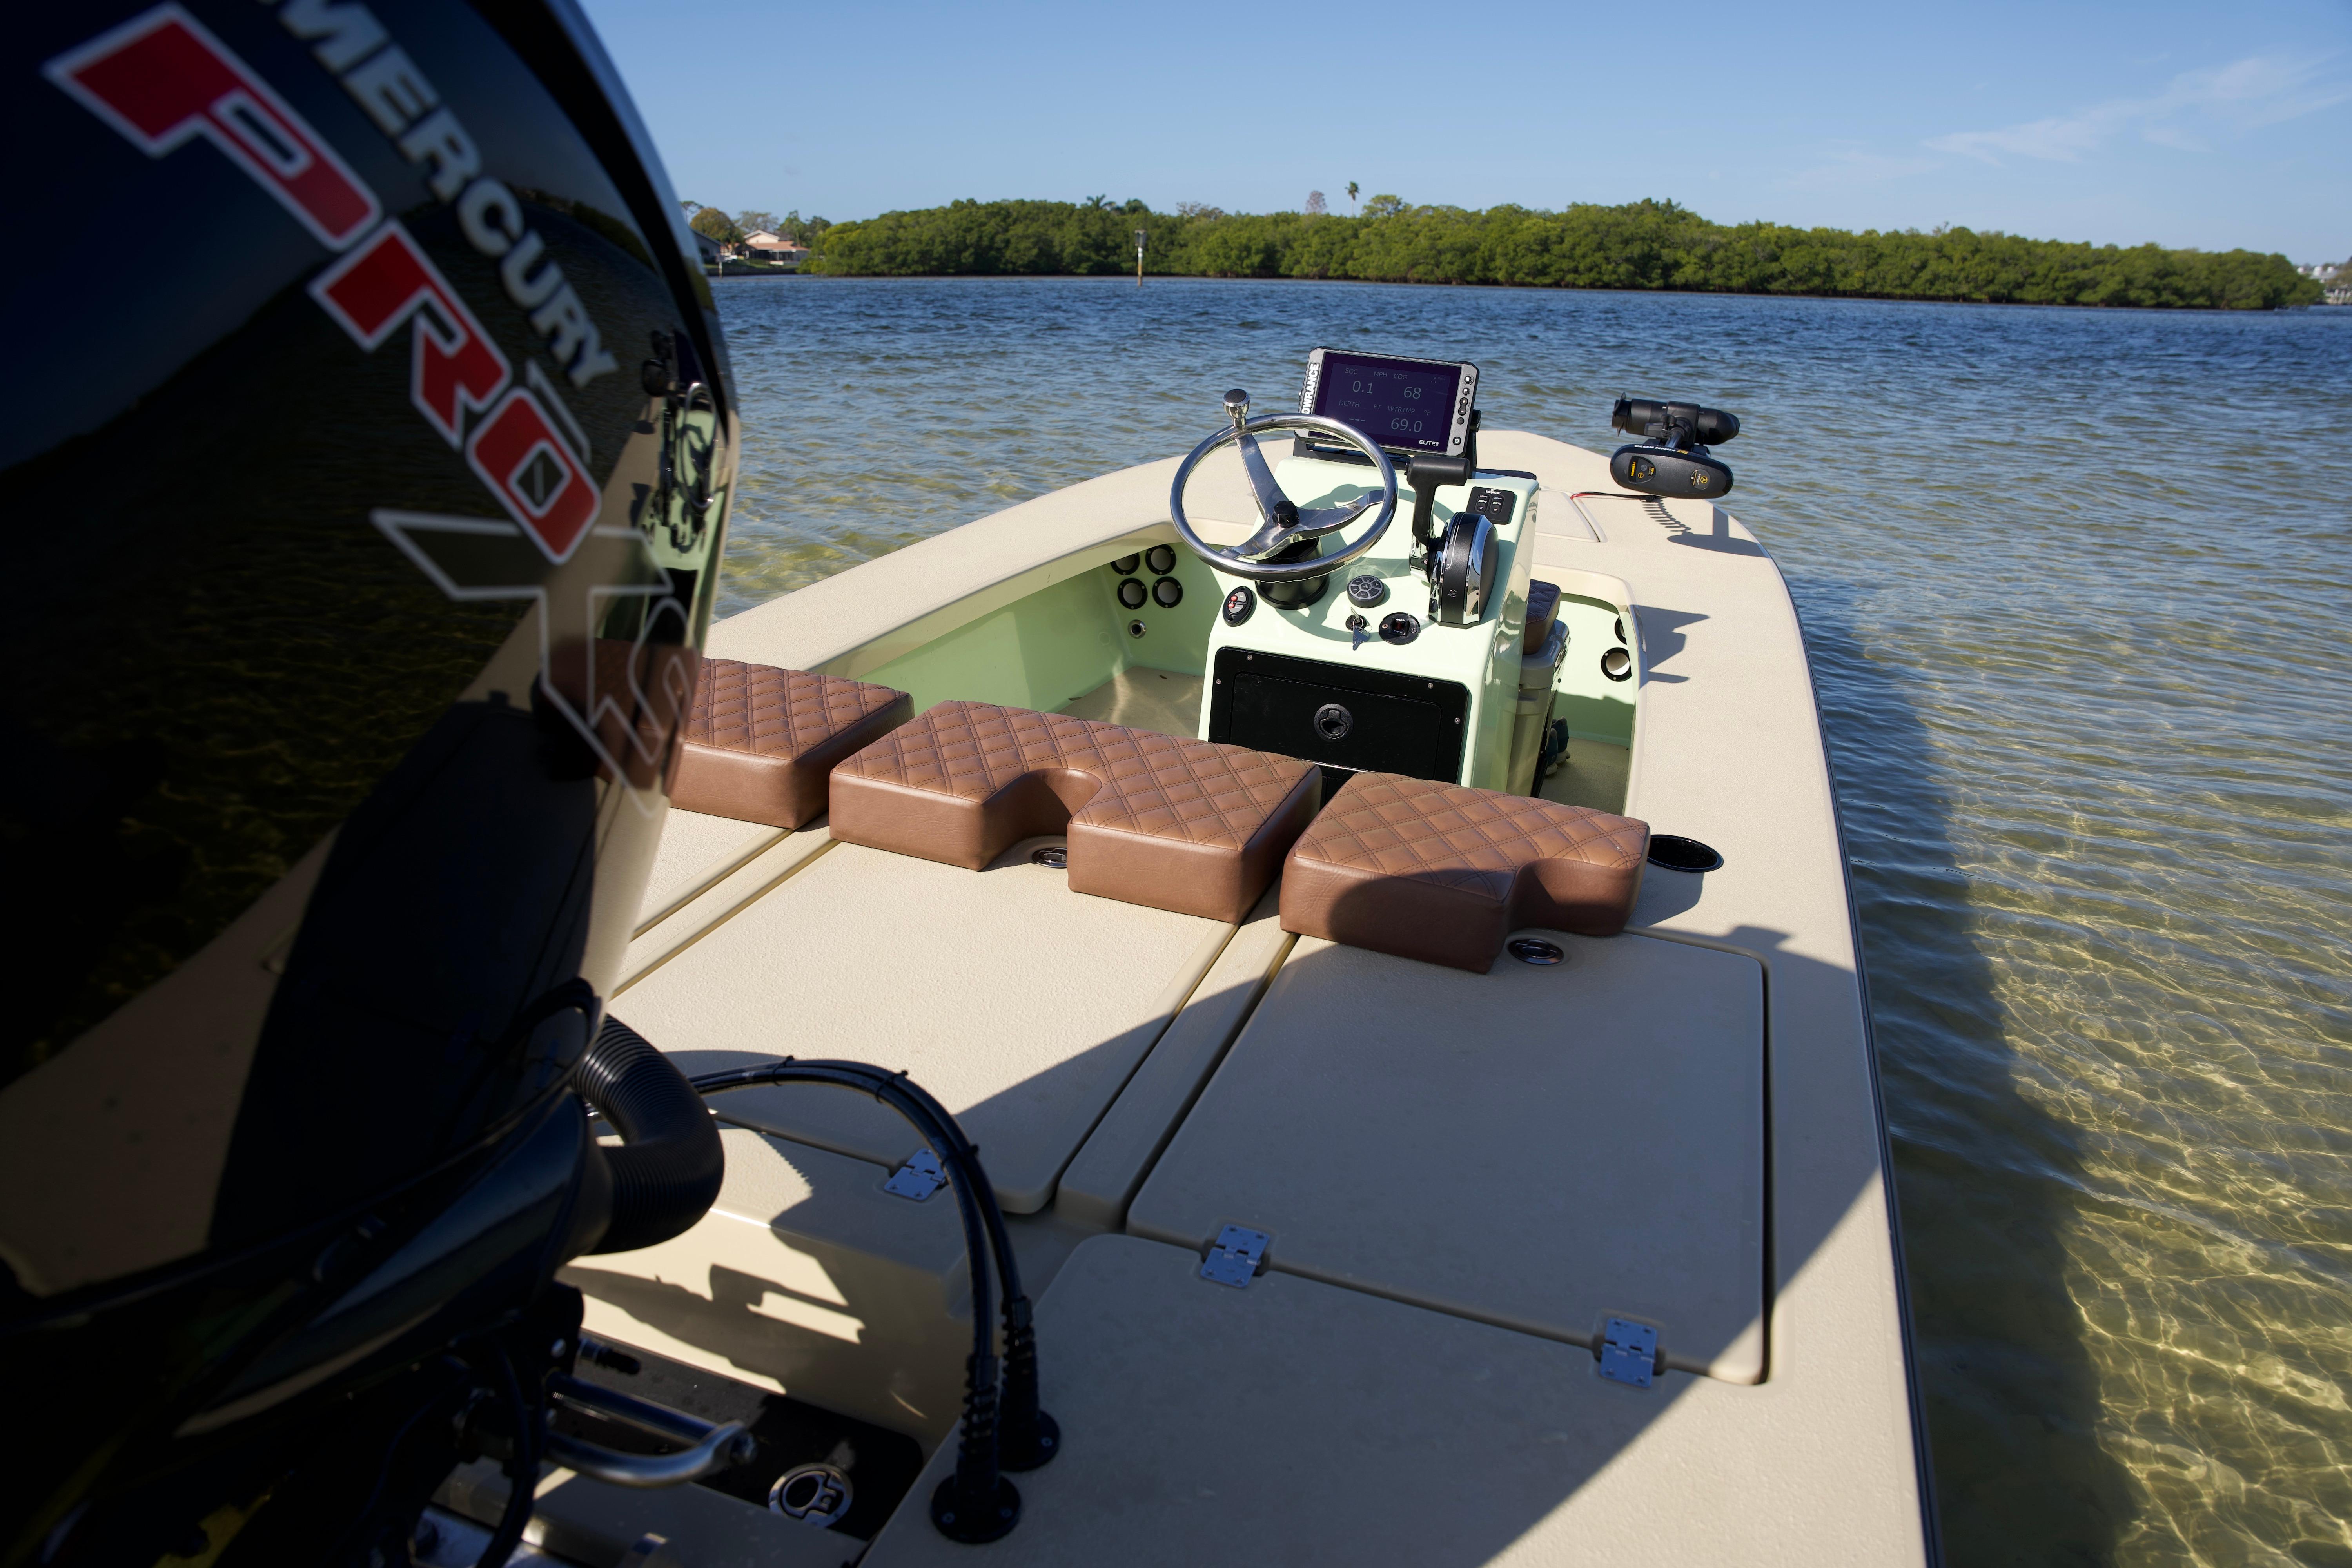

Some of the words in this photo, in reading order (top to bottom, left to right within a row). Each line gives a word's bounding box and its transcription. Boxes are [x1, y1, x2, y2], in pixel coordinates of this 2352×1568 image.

[42, 3, 602, 564] PRO
[1301, 363, 1319, 414] OWRANCE
[1352, 381, 1373, 394] 0.1
[1403, 387, 1421, 399] 68
[1391, 418, 1422, 432] 69.0
